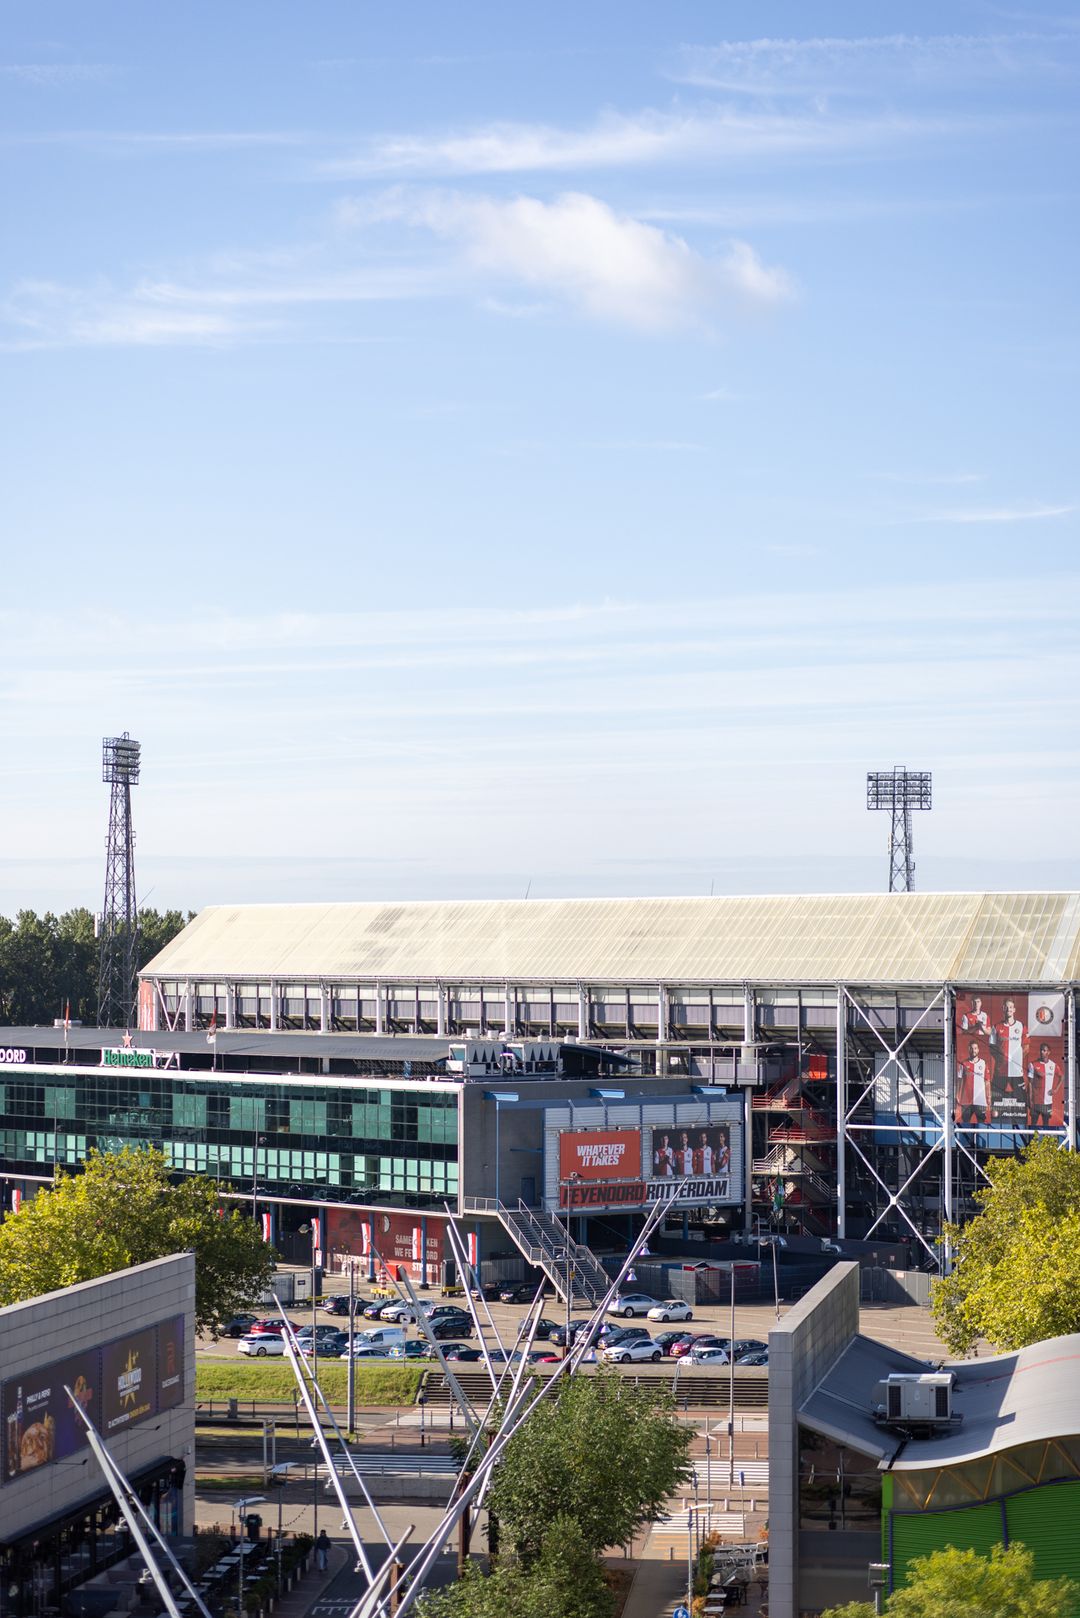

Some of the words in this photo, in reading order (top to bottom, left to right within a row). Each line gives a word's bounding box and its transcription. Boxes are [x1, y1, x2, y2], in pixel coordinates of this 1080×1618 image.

[103, 1049, 153, 1067] Heineken
[577, 1143, 626, 1157] WHATEVER
[582, 1155, 591, 1167] IT
[592, 1155, 619, 1166] TAKES
[563, 1184, 644, 1205] FEYENOORD
[646, 1180, 728, 1200] ROTTERDAM
[395, 1234, 414, 1245] SAME
[394, 1247, 403, 1257] WE
